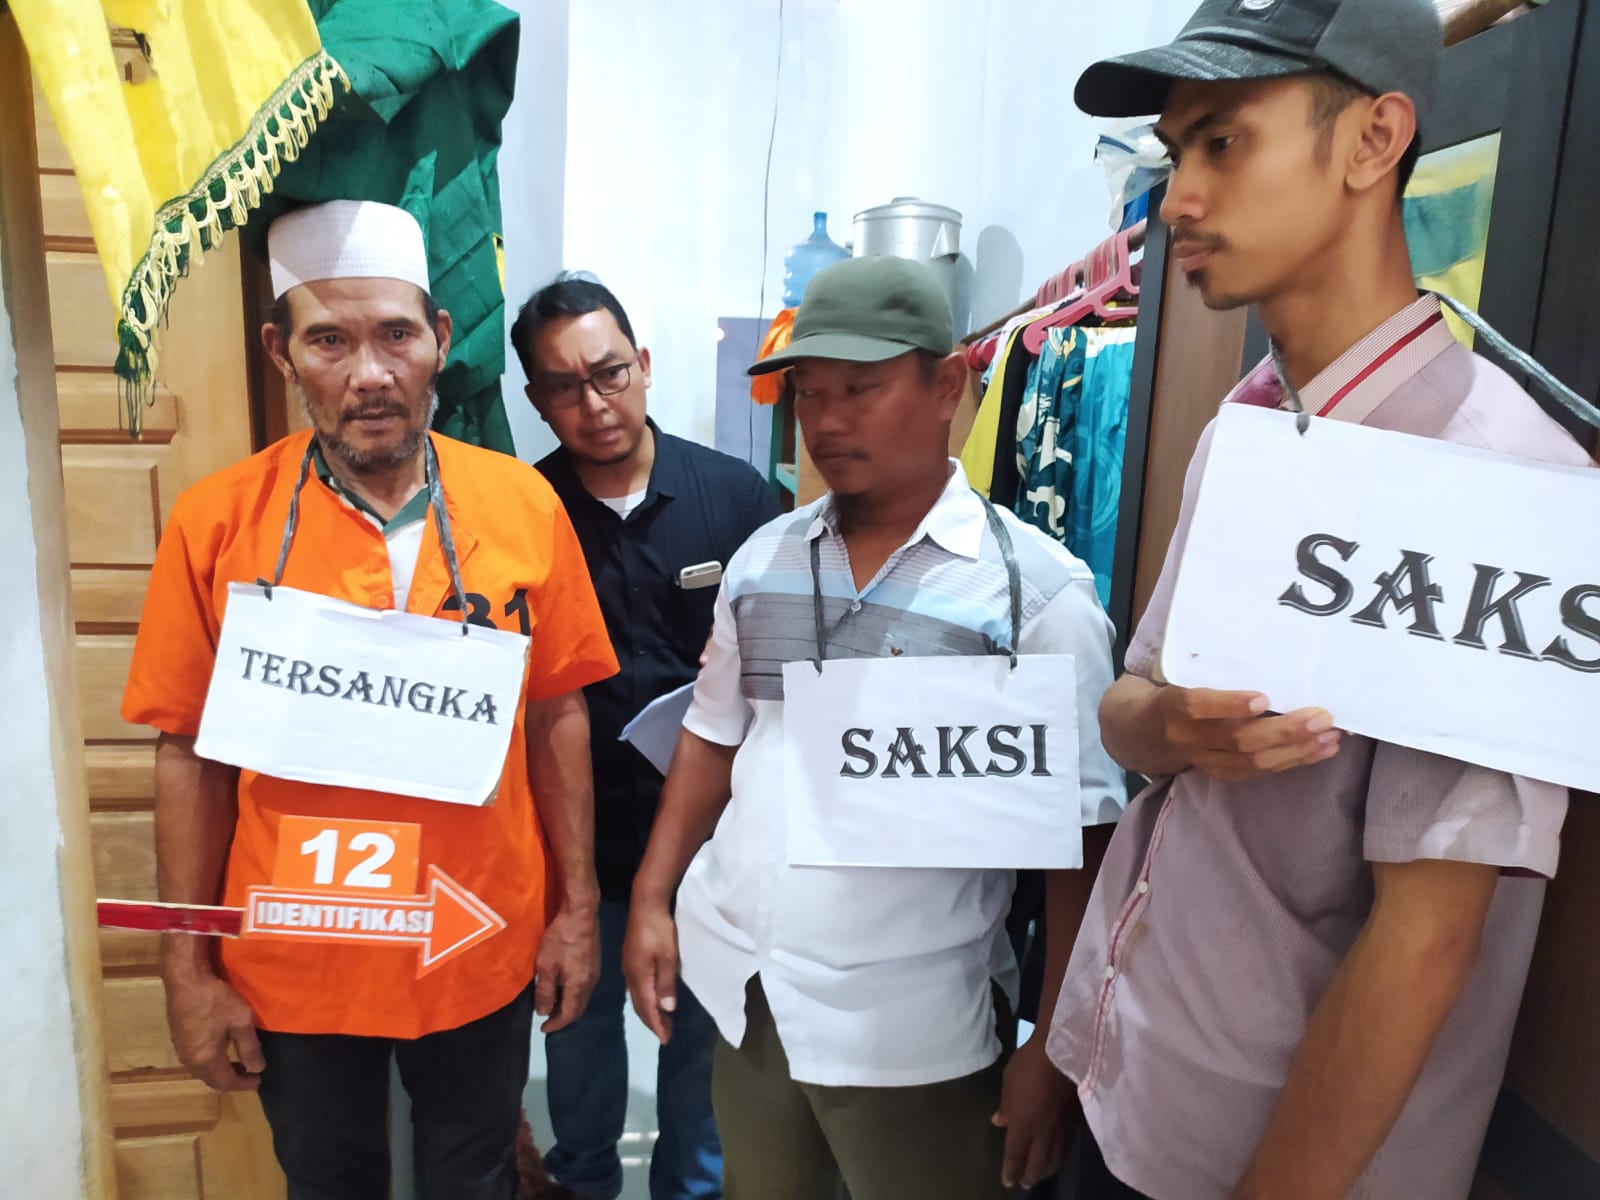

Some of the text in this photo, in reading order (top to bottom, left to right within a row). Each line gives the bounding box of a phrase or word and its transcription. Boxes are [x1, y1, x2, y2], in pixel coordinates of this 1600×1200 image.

[240, 647, 498, 725] TERSANGKA
[840, 724, 1052, 778] SAKSI
[300, 829, 396, 888] 12
[257, 900, 433, 933] IDENTIFIKASI
